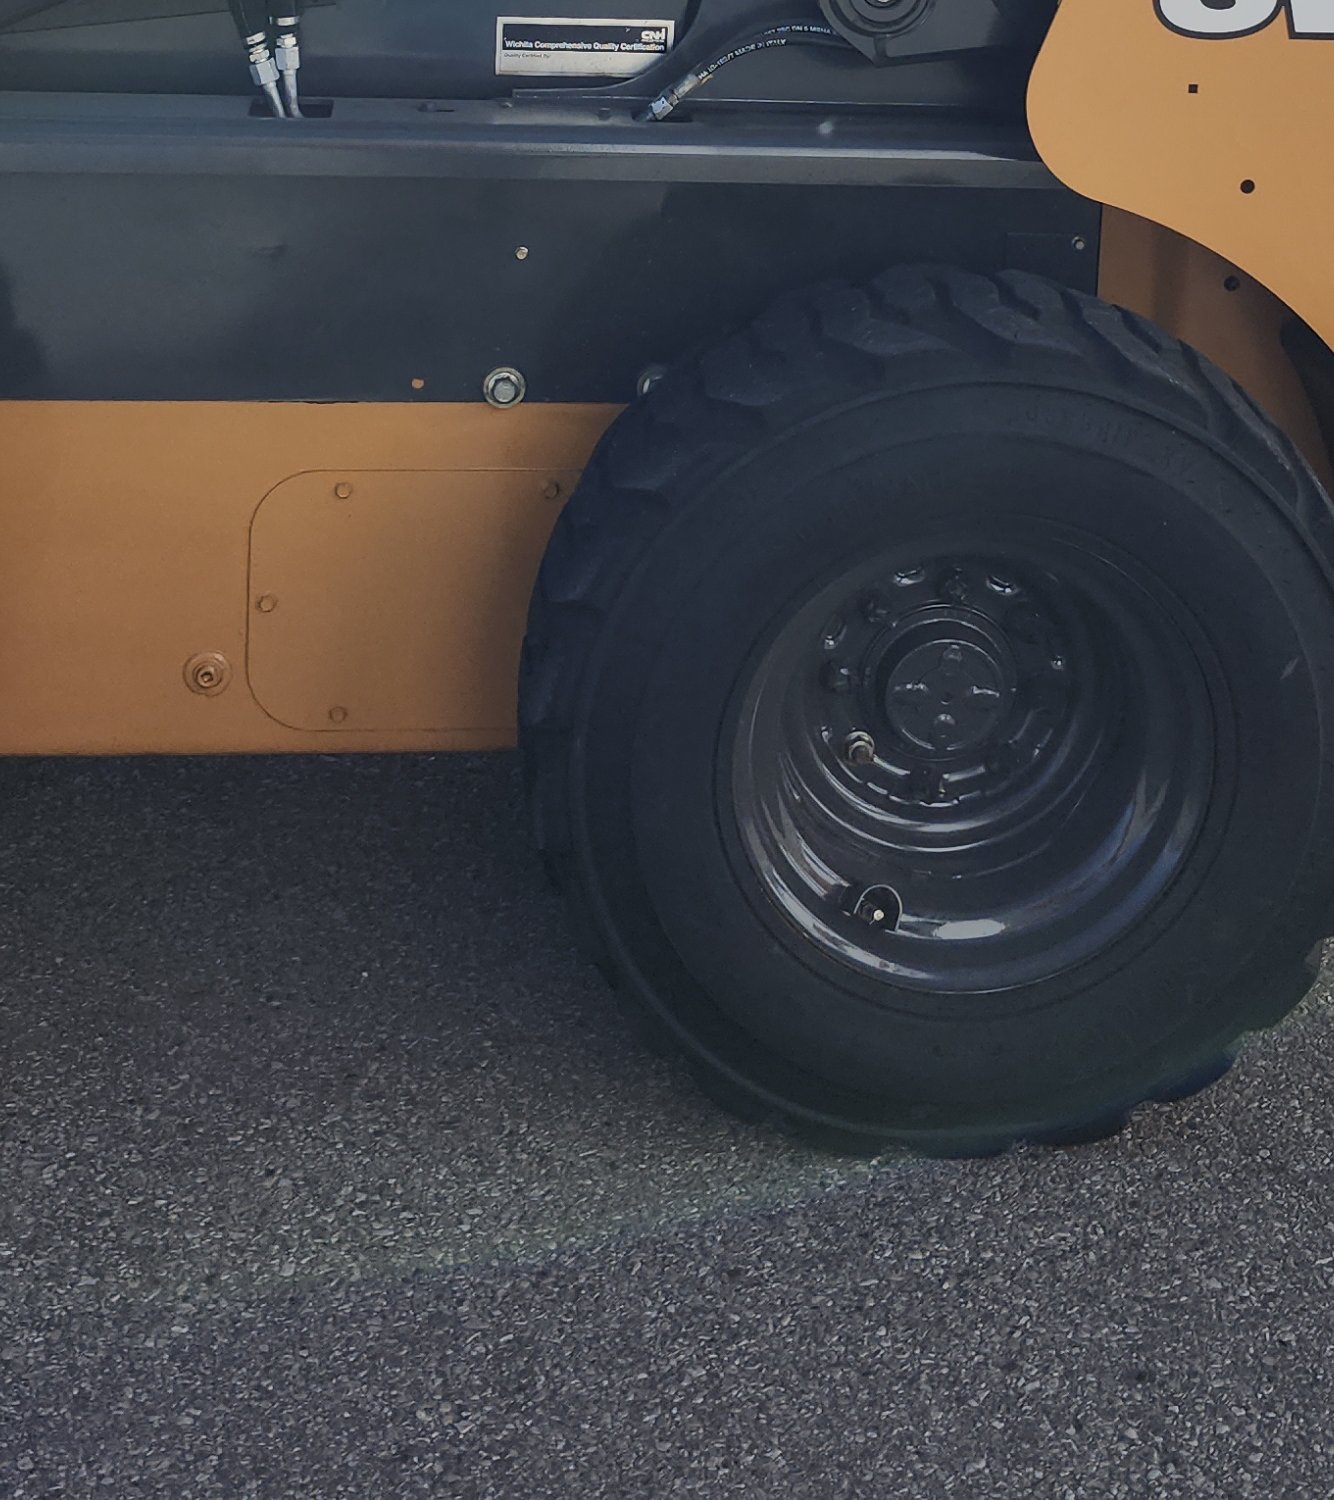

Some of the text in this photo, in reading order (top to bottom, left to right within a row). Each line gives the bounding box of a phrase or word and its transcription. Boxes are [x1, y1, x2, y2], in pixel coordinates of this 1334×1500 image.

[641, 28, 666, 40] CNH
[504, 40, 665, 52] Wichita Comprehensive Quality Certification
